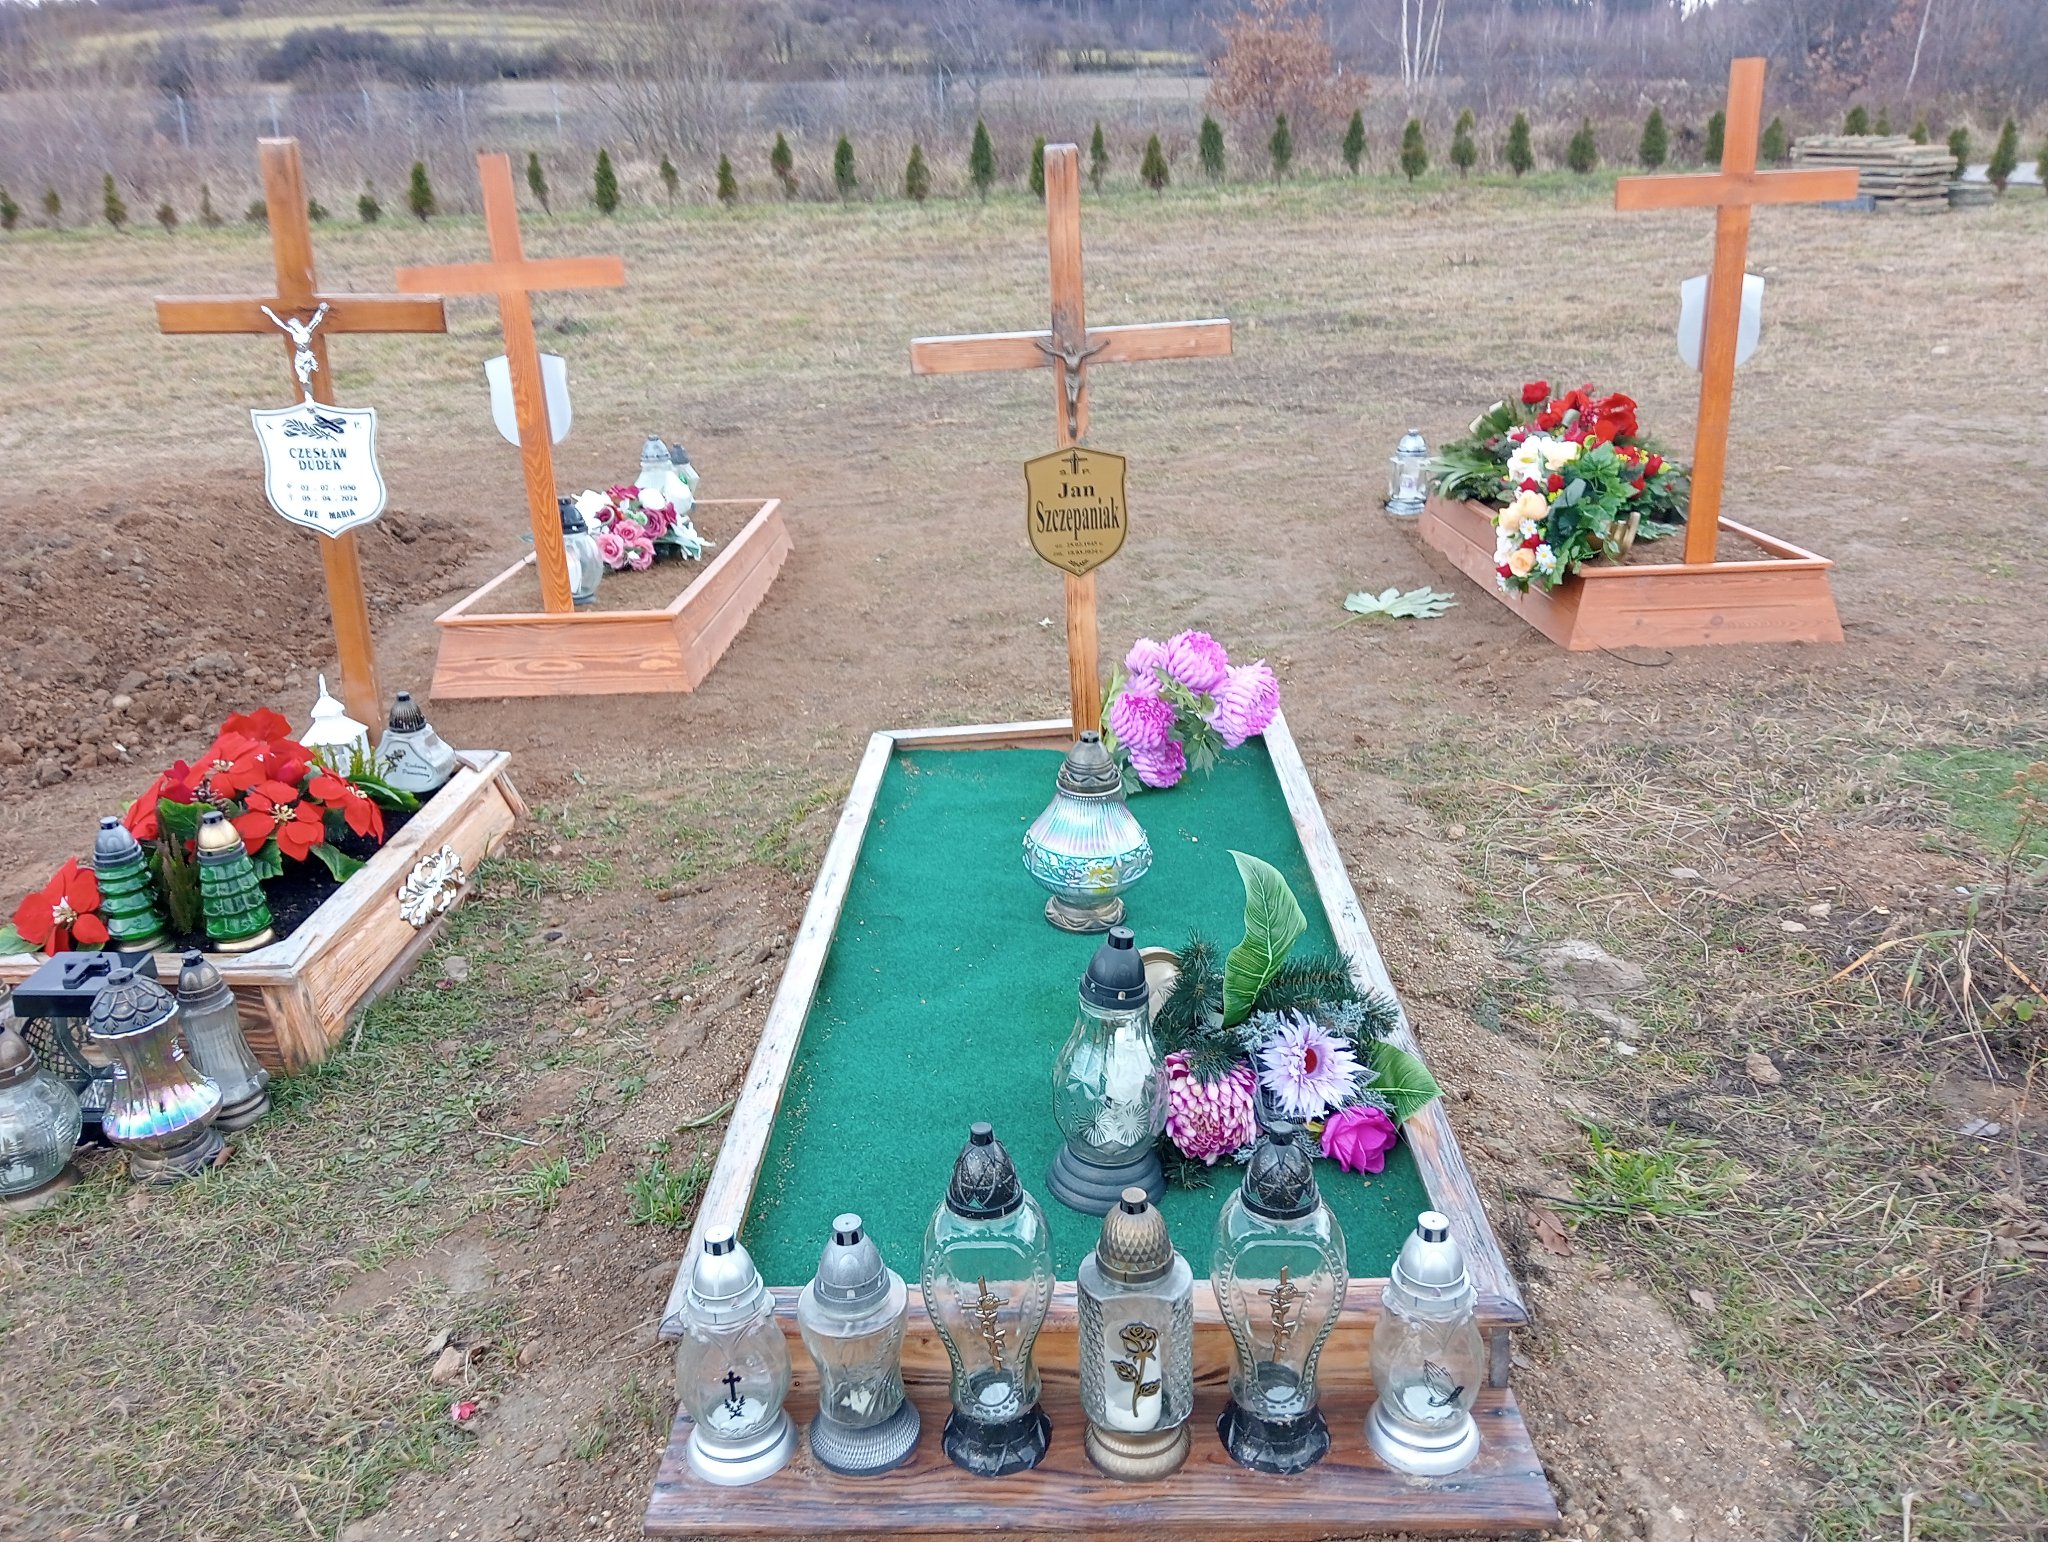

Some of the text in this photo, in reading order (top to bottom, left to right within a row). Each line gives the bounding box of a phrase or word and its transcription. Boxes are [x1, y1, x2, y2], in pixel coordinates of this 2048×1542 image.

[289, 447, 347, 459] CZESŁAW
[298, 459, 342, 471] DUDEK
[1057, 482, 1095, 499] Jan
[303, 508, 356, 520] AVE MARIA
[1035, 497, 1121, 541] Szczepaniak
